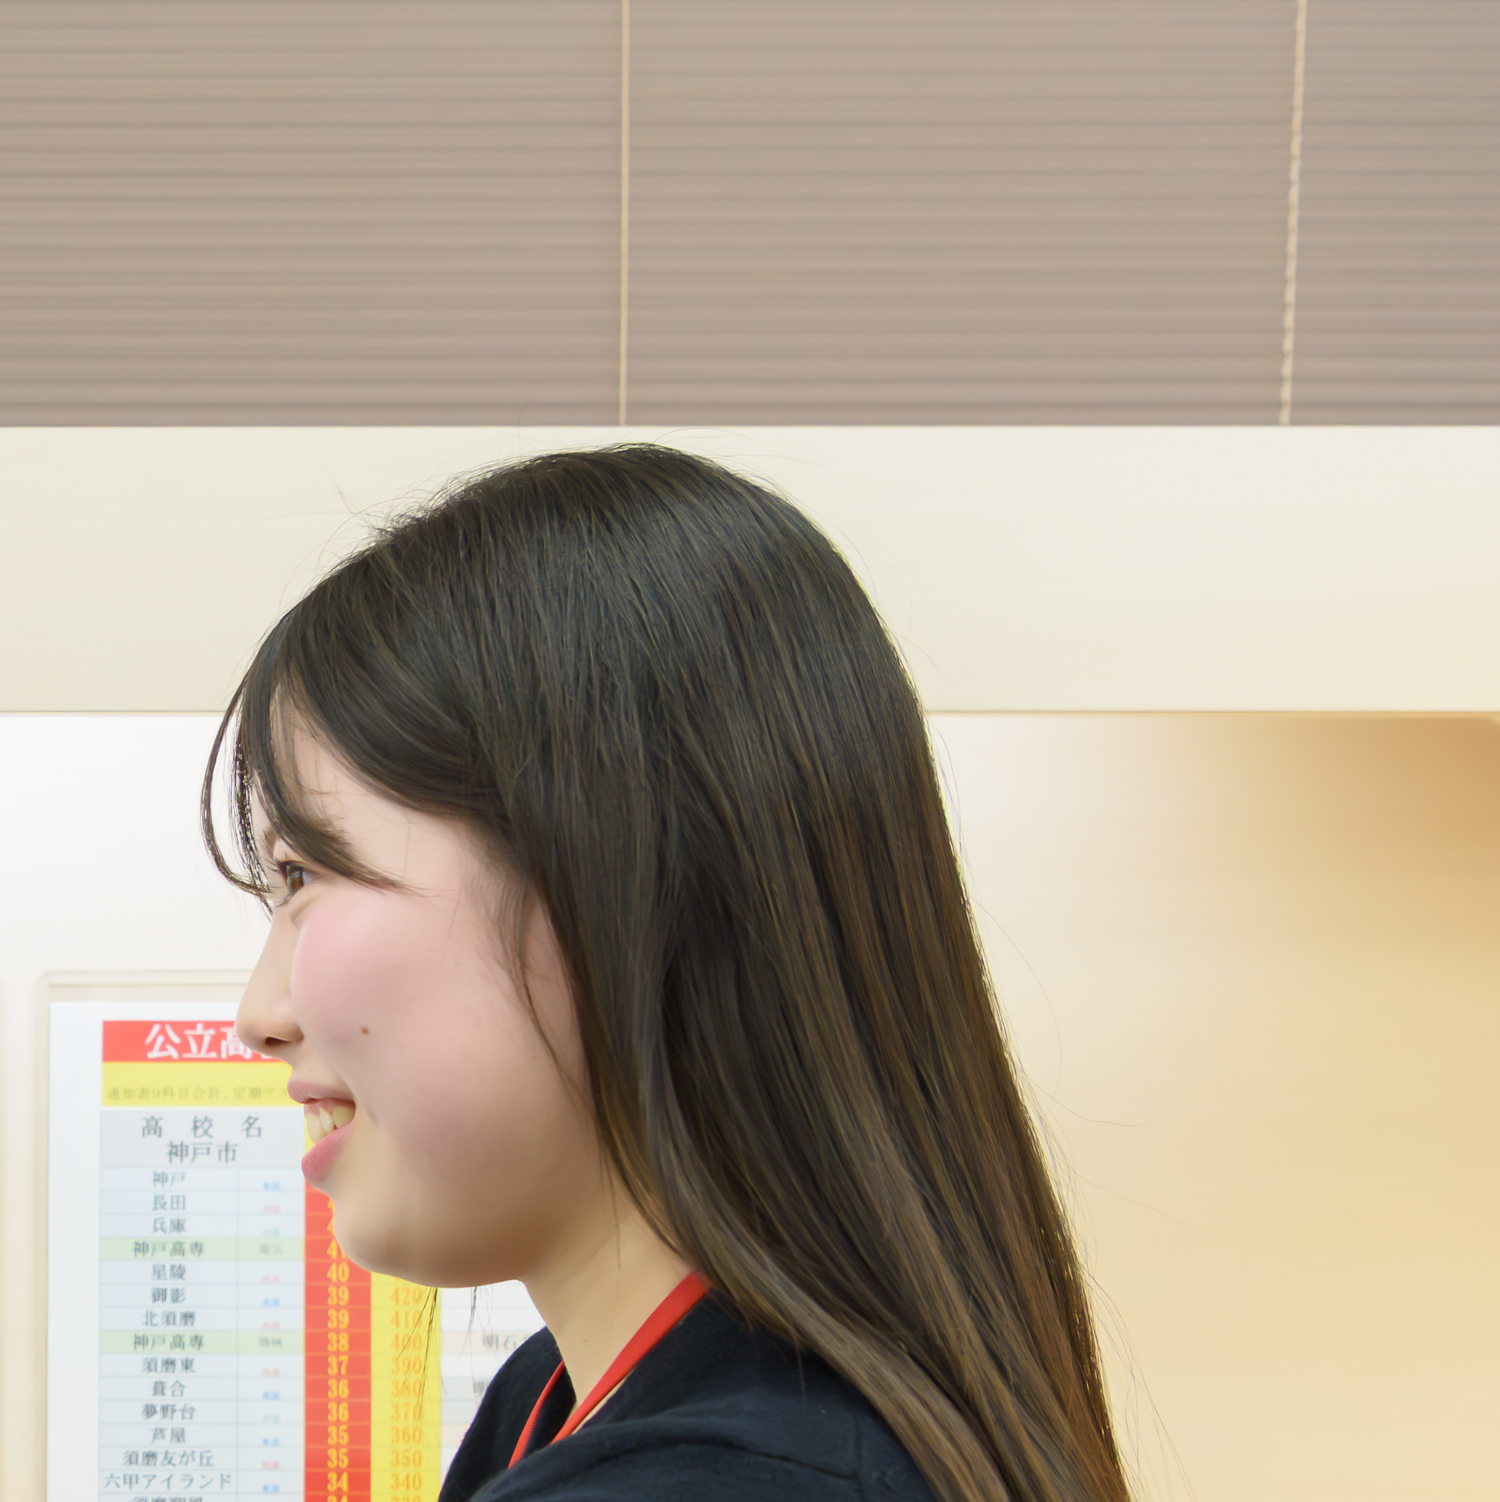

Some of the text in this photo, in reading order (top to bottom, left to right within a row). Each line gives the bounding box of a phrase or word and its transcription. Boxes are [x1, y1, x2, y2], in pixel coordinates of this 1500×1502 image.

[165, 1140, 240, 1164] 神戸市
[151, 1170, 186, 1188] 神戸
[151, 1193, 187, 1212] 長田
[152, 1216, 186, 1235] 兵庫
[132, 1239, 204, 1258] 神戸高専
[151, 1263, 187, 1281] 星陵
[327, 1263, 350, 1282] 40
[150, 1287, 186, 1305] 御影
[142, 1310, 196, 1328] 北須磨
[326, 1310, 349, 1329] 39
[132, 1333, 205, 1351] 神戸高専
[143, 1356, 195, 1374] 須磨東
[326, 1356, 349, 1375] 37
[151, 1379, 186, 1398] 葺合
[141, 1403, 196, 1421] 夢野台
[326, 1402, 349, 1421] 36
[150, 1426, 187, 1445] 芦屋
[124, 1449, 212, 1467] 須磨友が丘
[104, 1473, 231, 1491] 六甲アイランド
[325, 1472, 348, 1491] 34
